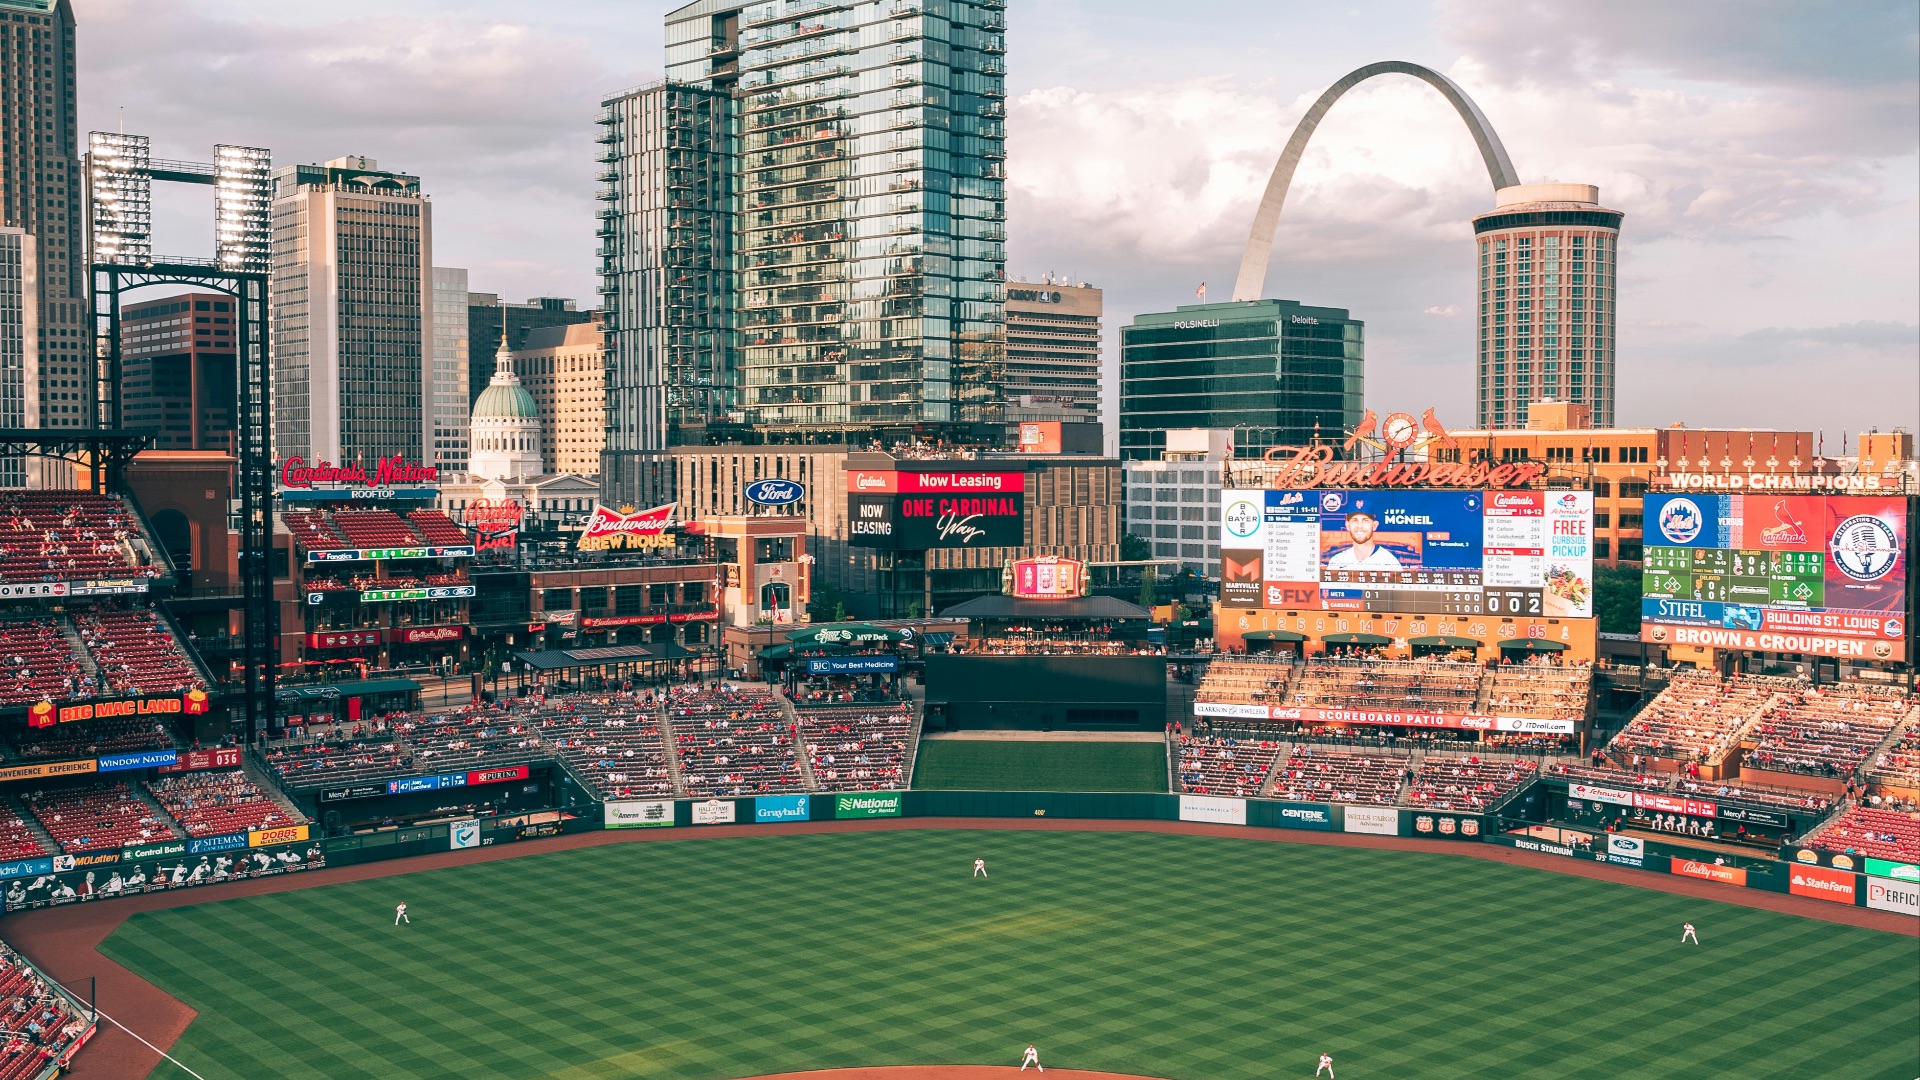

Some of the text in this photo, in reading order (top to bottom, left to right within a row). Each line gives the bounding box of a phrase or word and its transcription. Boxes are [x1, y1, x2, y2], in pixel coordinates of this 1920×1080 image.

[1174, 319, 1219, 329] POLSINELLI
[282, 456, 438, 488] Cardinals Nation
[1265, 445, 1548, 490] Budweiser
[857, 473, 886, 490] Cardinals
[919, 474, 1002, 489] Now Leasing
[1670, 473, 1880, 489] WORLD CHAMPIONS
[352, 490, 394, 498] ROOFTOP
[758, 483, 793, 500] Ford
[1494, 493, 1534, 507] Cardinals
[465, 498, 523, 527] Bally
[860, 505, 883, 518] NOW
[903, 498, 1018, 517] ONE CARDINAL
[478, 522, 509, 532] SPORTS
[580, 515, 675, 533] Budweiser
[937, 509, 985, 543] Way
[1385, 516, 1433, 525] MCNEIL
[1554, 520, 1586, 535] FREE
[1718, 518, 1743, 526] VERSUS
[852, 521, 892, 535] LEASING
[475, 532, 515, 551] Live!
[580, 534, 676, 550] BREW HOUSE
[1552, 536, 1586, 544] CURBSIDE
[1761, 527, 1807, 546] Cardinals
[1552, 545, 1586, 557] PICKUP
[1284, 590, 1314, 602] FLY
[1488, 598, 1499, 611] 0
[1510, 598, 1520, 612] 0
[1529, 598, 1539, 612] 2
[1659, 600, 1705, 618] STIFEL
[592, 618, 628, 626] Budweiser
[1263, 617, 1546, 638] 1 2 6 9 10 14 17 20 24 42 45 85
[1767, 612, 1879, 629] BUILDING ST. LOUIS
[1676, 629, 1862, 655] BROWN & CROUPPEN
[813, 662, 828, 670] BJC
[60, 699, 181, 722] BIG MAC LAND
[1273, 708, 1301, 719] Coca-Cola
[1319, 710, 1444, 725] SCOREBOARD PATIO
[1461, 716, 1492, 728] Coca-Cola
[49, 763, 90, 773] EXPERIENCE
[100, 754, 175, 768] WINDOW NATION
[488, 770, 516, 779] PURINA
[1282, 809, 1324, 819] CENTENE
[1372, 815, 1395, 823] FARGO
[1724, 810, 1741, 819] Mercy
[452, 820, 478, 829] CarShield
[204, 835, 245, 846] SITEMAN
[262, 828, 297, 840] DOBBS
[135, 844, 185, 857] Central Bank
[1516, 840, 1572, 856] BUSCH STADIUM
[1618, 840, 1634, 849] Ford
[75, 854, 119, 866] MOLottery
[1683, 862, 1732, 879] Bally SPORTS
